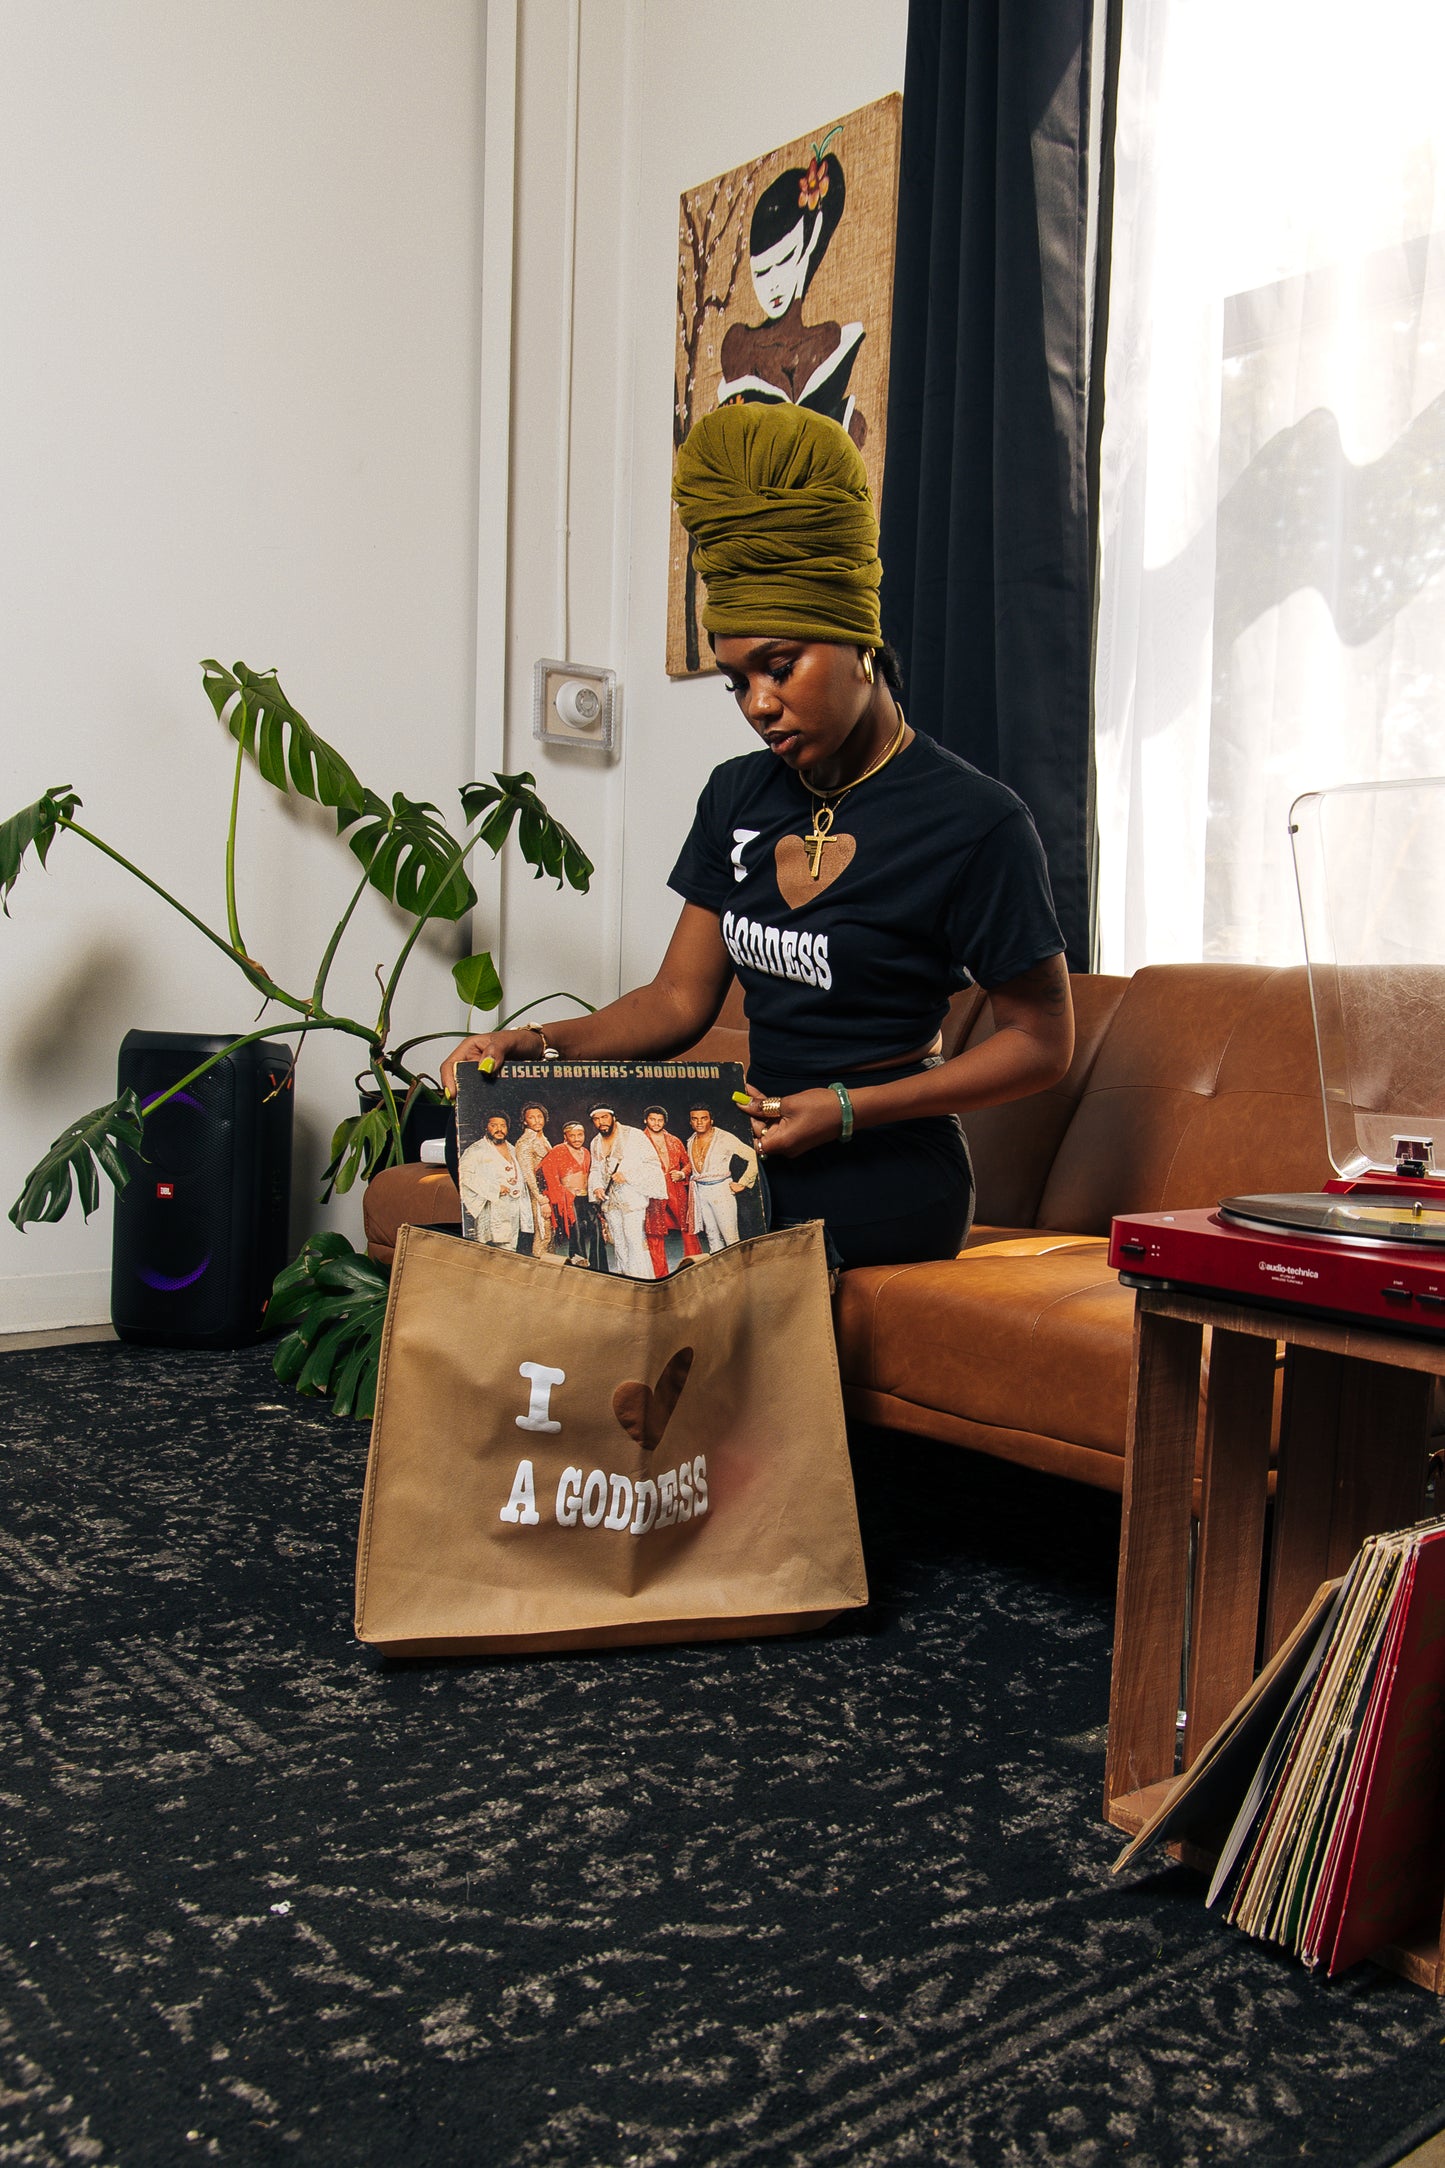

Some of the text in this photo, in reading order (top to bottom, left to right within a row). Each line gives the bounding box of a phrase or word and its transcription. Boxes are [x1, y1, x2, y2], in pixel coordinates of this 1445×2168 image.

[723, 911, 832, 990] GODDESS
[511, 1065, 550, 1078] ISLEY
[1265, 1263, 1319, 1279] audio-technica
[515, 1361, 565, 1433] I
[500, 1454, 708, 1535] A GODDESS
